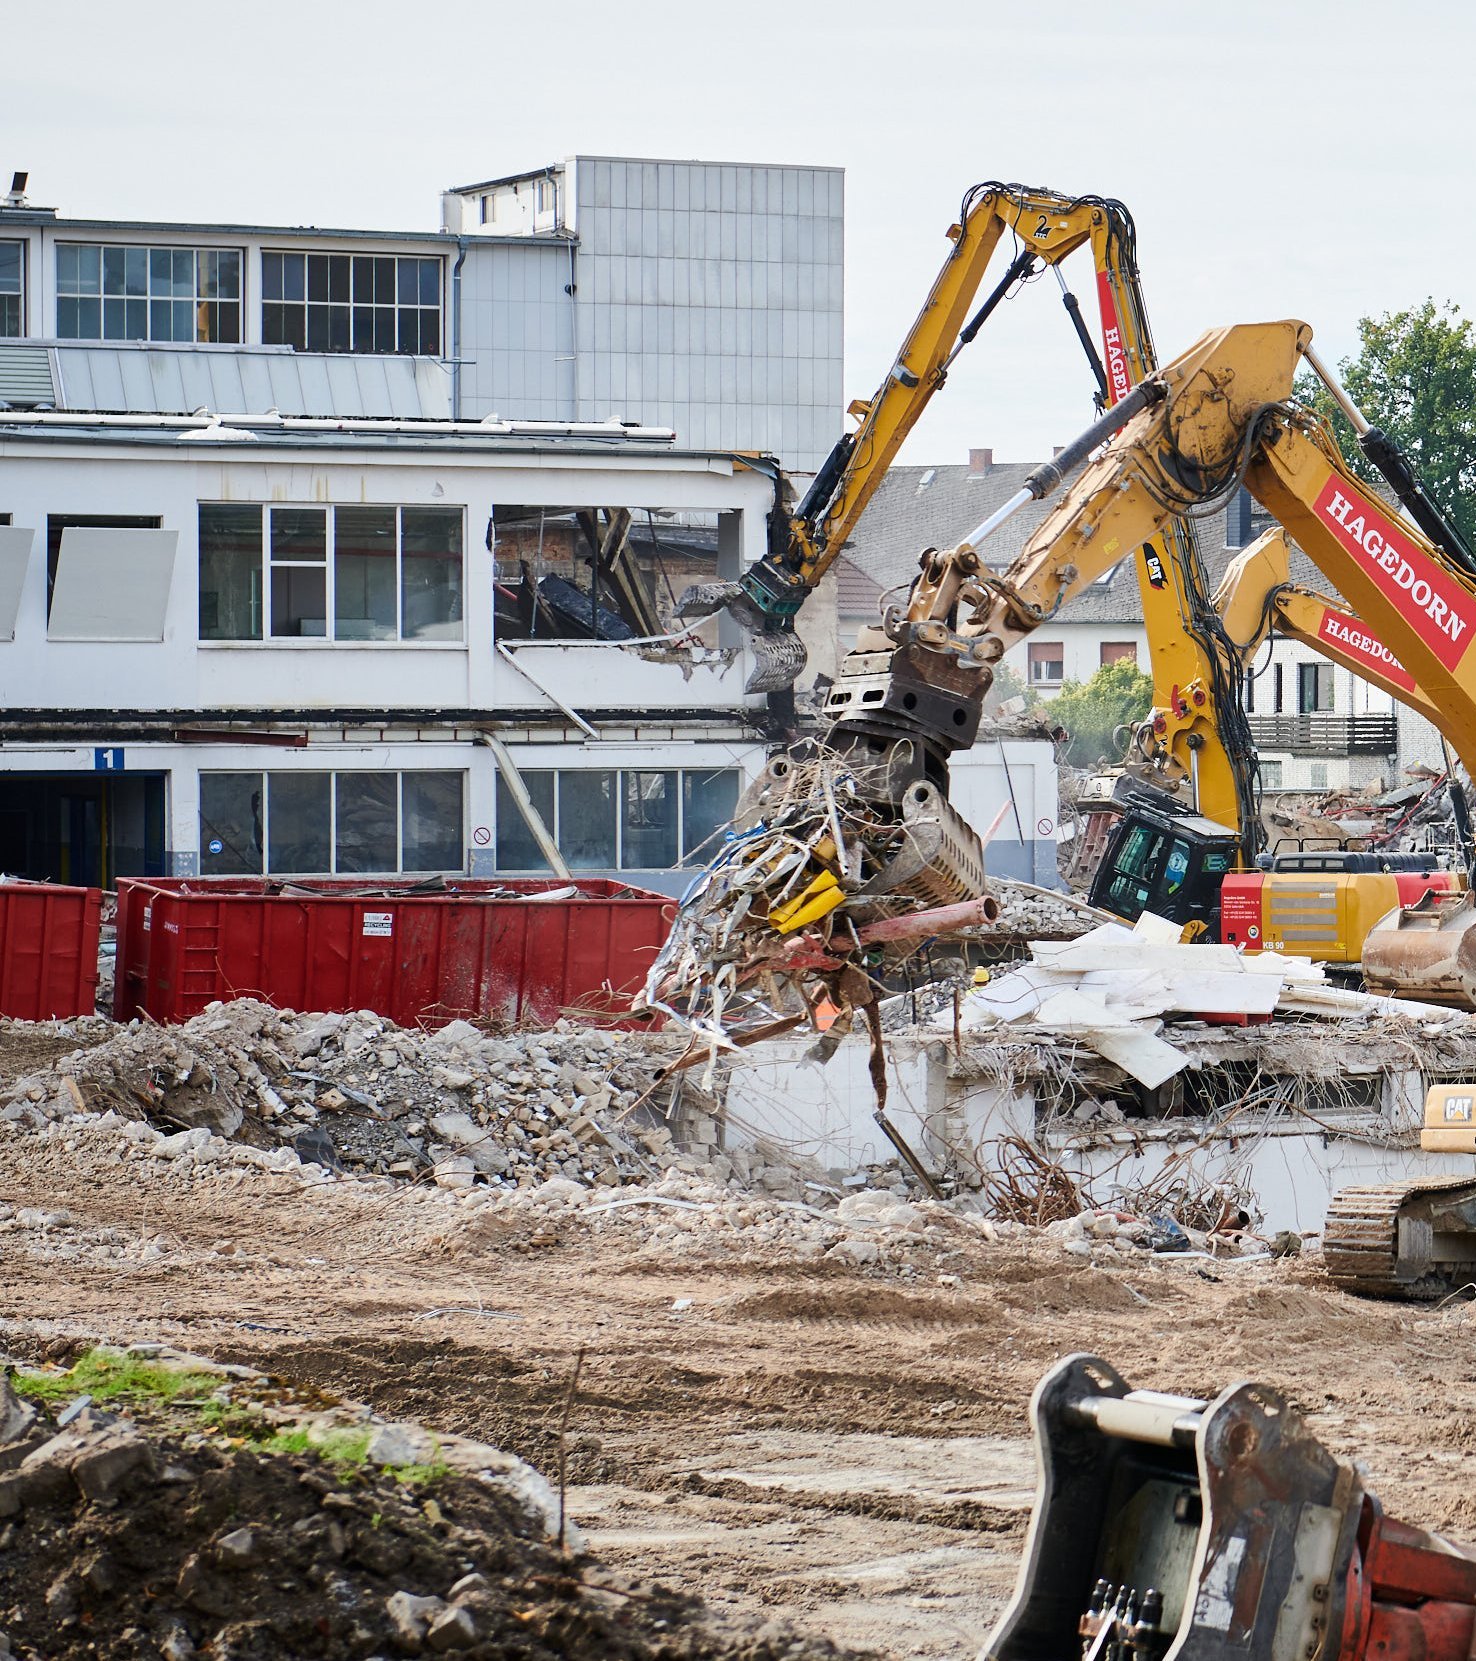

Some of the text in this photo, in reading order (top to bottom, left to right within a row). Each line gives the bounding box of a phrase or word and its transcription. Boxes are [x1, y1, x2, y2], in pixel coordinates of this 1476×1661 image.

[1147, 557, 1162, 580] CAT
[1325, 490, 1467, 642] HAGEDORN
[102, 749, 114, 769] 1
[1262, 941, 1285, 950] KB 90
[1446, 1098, 1472, 1120] CAT
